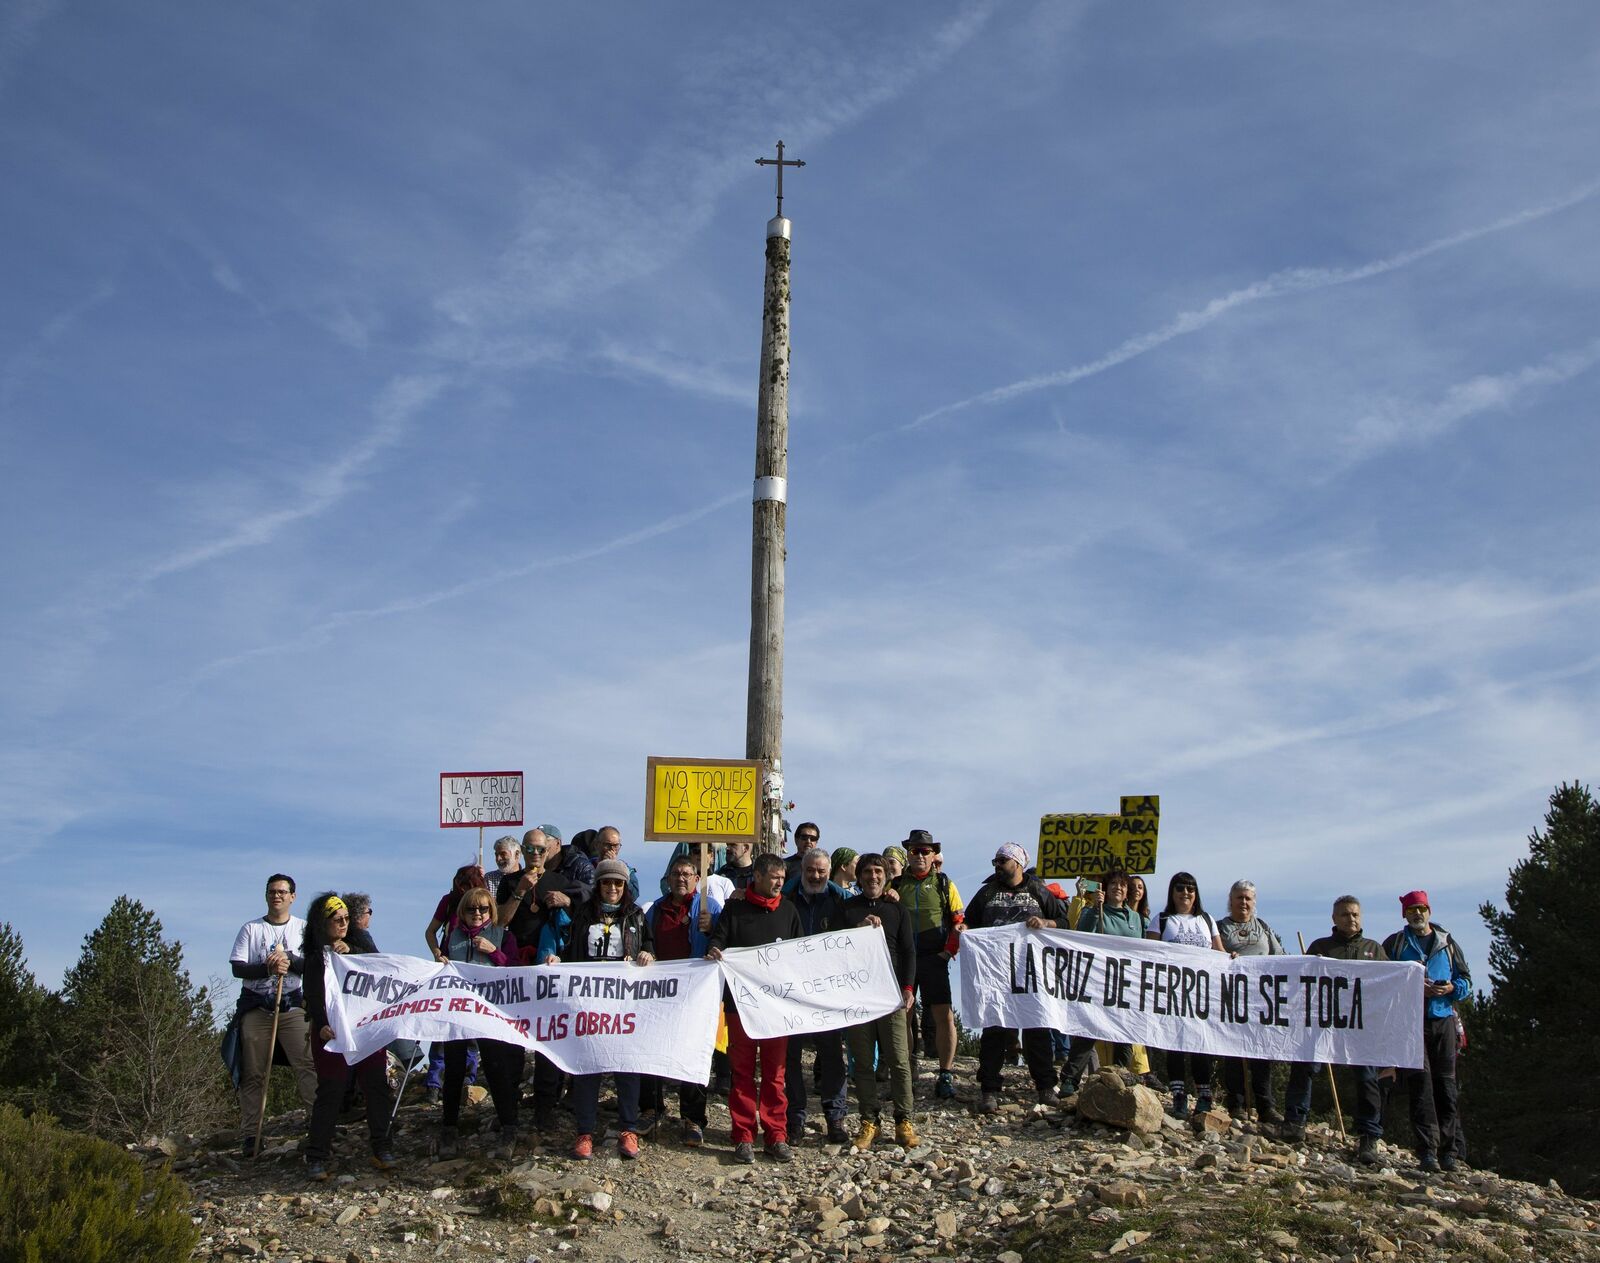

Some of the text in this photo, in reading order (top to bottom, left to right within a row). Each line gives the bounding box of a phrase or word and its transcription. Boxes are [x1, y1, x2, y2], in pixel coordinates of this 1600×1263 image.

[452, 777, 518, 794] LA CRUZ
[664, 771, 688, 789] NO
[457, 796, 511, 807] DE FERRO
[668, 790, 748, 810] LA CRUZ
[1121, 796, 1159, 816] LA
[446, 806, 518, 823] NO SE TOCA
[666, 810, 748, 830] DE FERRO
[1041, 819, 1158, 835] CRUZ PARA
[1127, 839, 1153, 856] ES
[1042, 855, 1155, 876] PROFANARLA
[758, 935, 856, 967] NO SE TOCA
[536, 974, 560, 1000] DE
[568, 975, 678, 1000] PATRIMONIO
[759, 982, 800, 1004] RUZ
[803, 980, 826, 996] DE
[823, 969, 870, 991] FERRO
[1010, 942, 1364, 1030] LA CRUZ DE FERRO NO SE TOCA
[536, 1014, 569, 1042] LAS
[575, 1012, 636, 1037] OBRAS
[784, 1005, 870, 1032] NO SE TOCA
